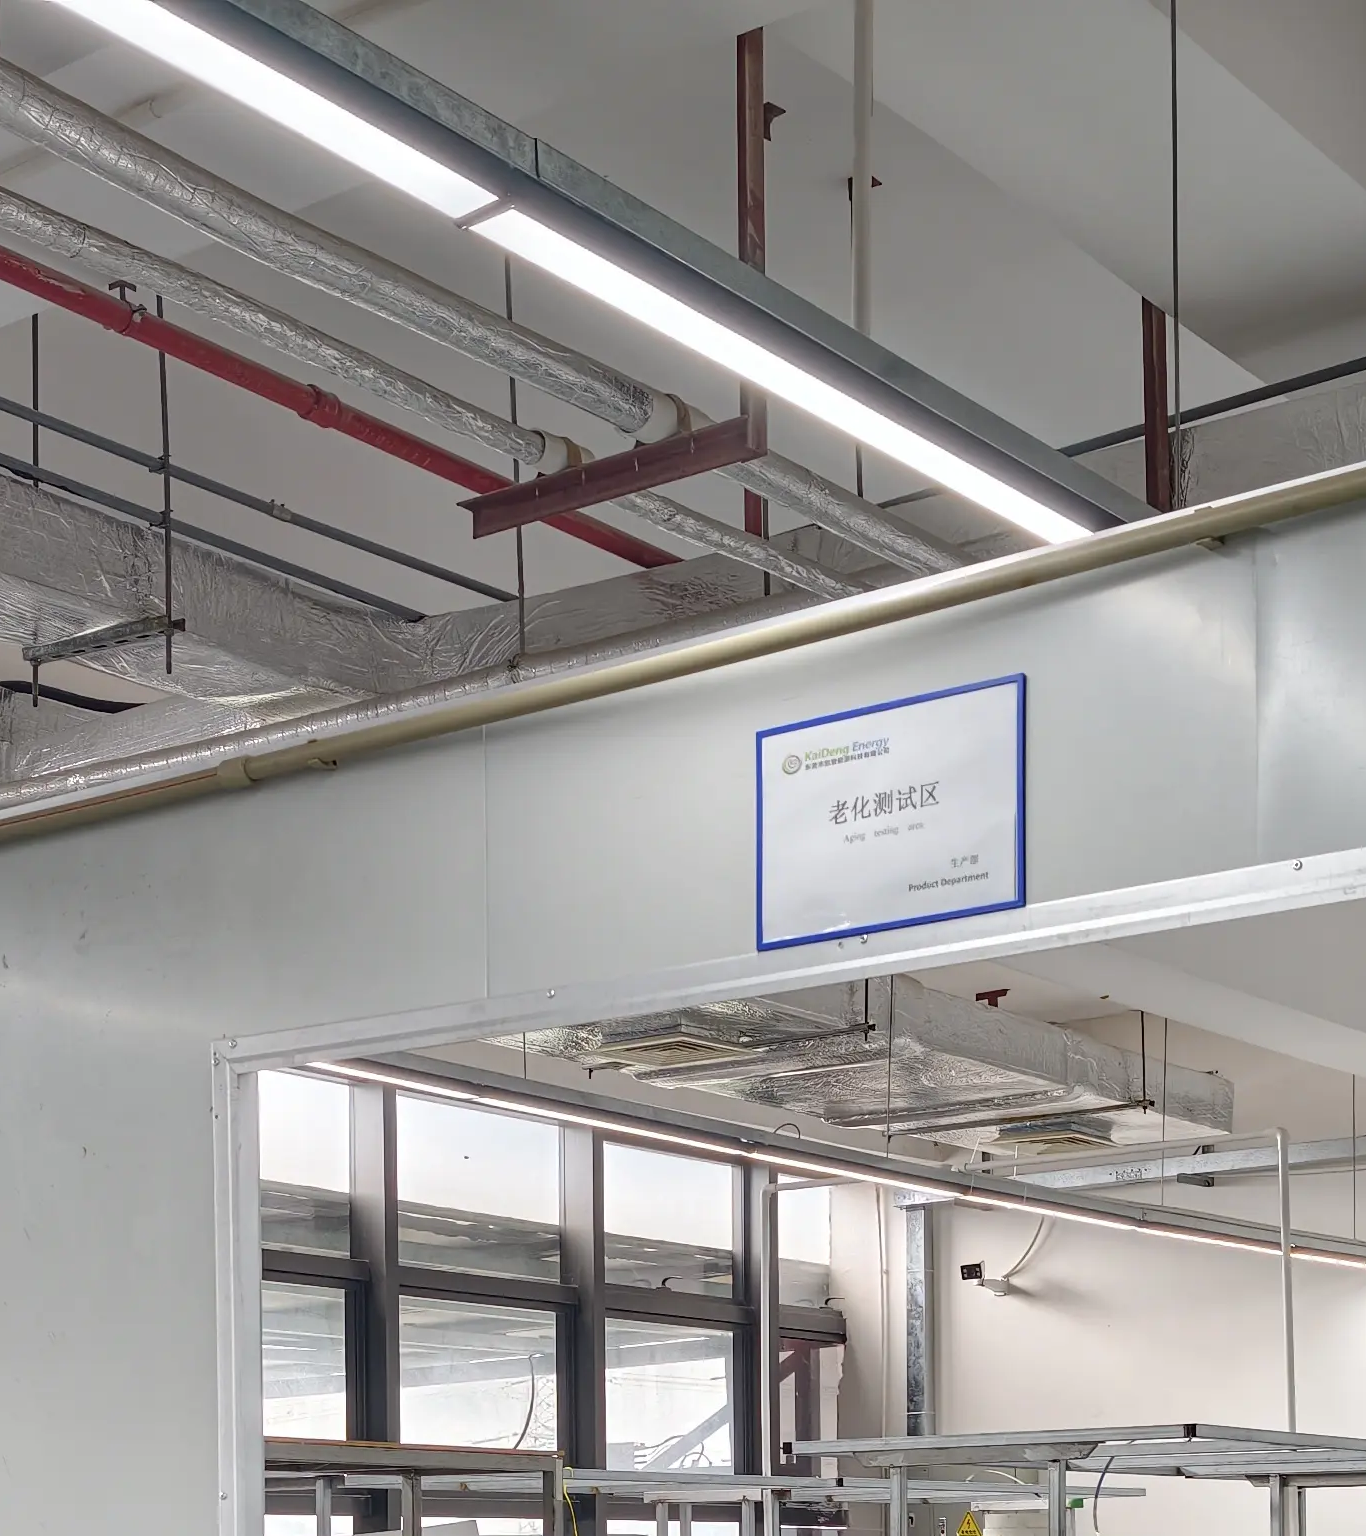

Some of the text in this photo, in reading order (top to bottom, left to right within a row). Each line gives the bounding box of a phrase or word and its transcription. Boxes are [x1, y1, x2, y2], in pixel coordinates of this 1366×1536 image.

[804, 737, 890, 761] KaiDeng Energy
[828, 781, 940, 825] 老化测试区
[843, 832, 866, 844] Aging
[908, 871, 989, 892] Product Department
